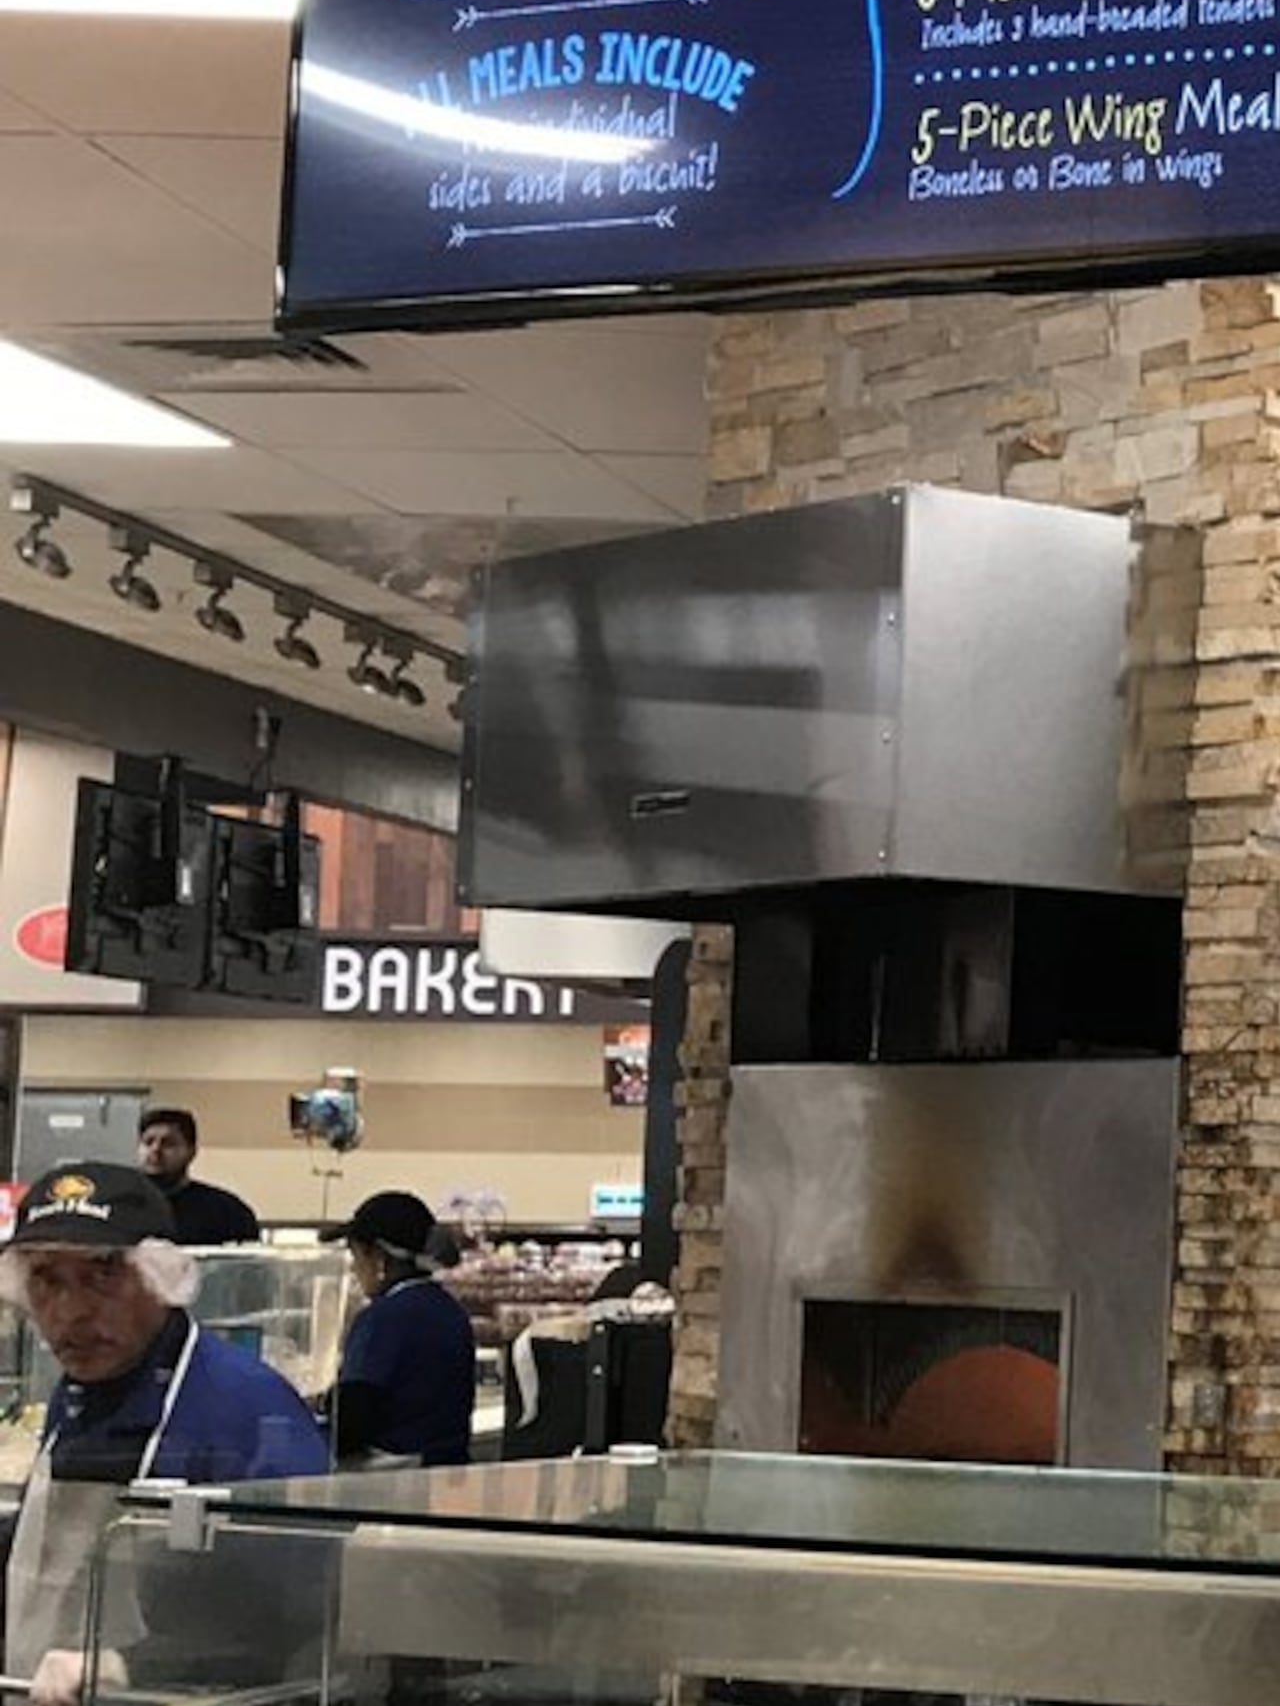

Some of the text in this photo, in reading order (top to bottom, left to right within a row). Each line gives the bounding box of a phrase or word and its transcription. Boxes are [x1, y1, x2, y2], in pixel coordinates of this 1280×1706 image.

[921, 15, 1004, 49] Includes
[1011, 12, 1024, 43] 3
[467, 34, 585, 105] MEALS
[596, 32, 755, 112] INCLUDE
[911, 104, 1053, 165] 5-Piece
[1065, 94, 1167, 153] Wing
[429, 142, 718, 211] sides and a biscuit!
[909, 149, 1223, 201] Boneless or Bone in wings
